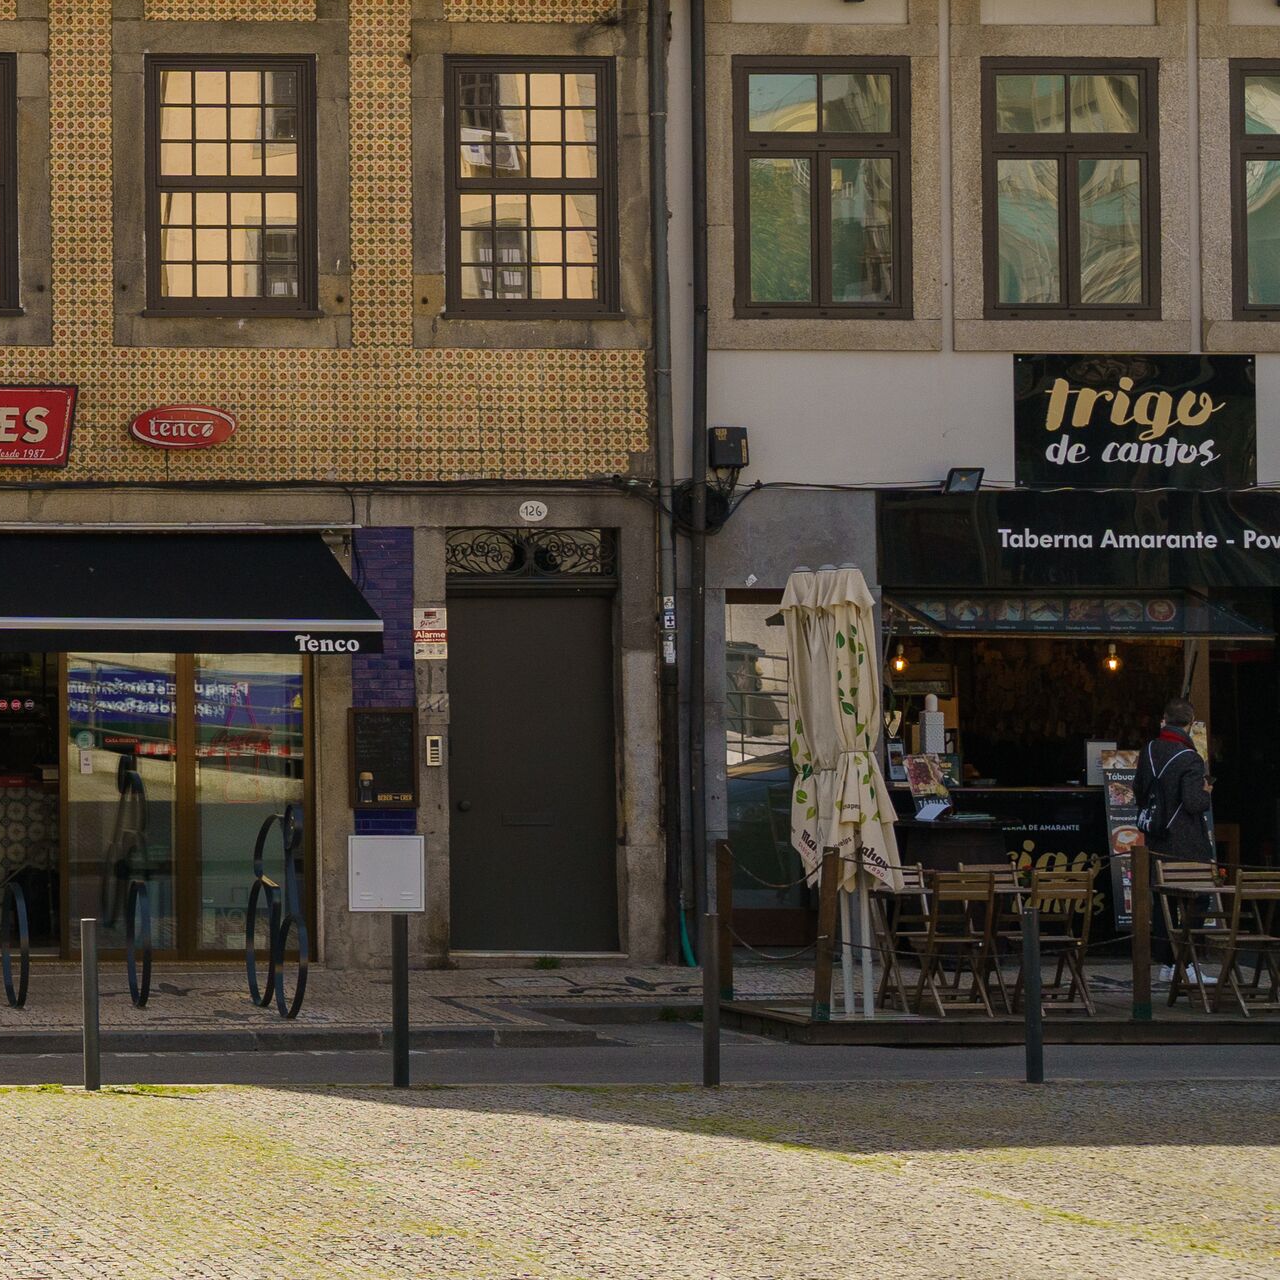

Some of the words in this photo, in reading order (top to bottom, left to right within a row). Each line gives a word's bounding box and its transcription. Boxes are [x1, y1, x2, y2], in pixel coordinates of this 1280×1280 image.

[1044, 376, 1226, 441] trigo
[22, 448, 46, 459] 1987
[1045, 434, 1090, 465] de
[1101, 437, 1221, 467] cantos
[523, 505, 543, 517] 126
[997, 528, 1093, 548] Taberna
[1100, 529, 1218, 549] Amarante
[294, 634, 360, 652] Tenco
